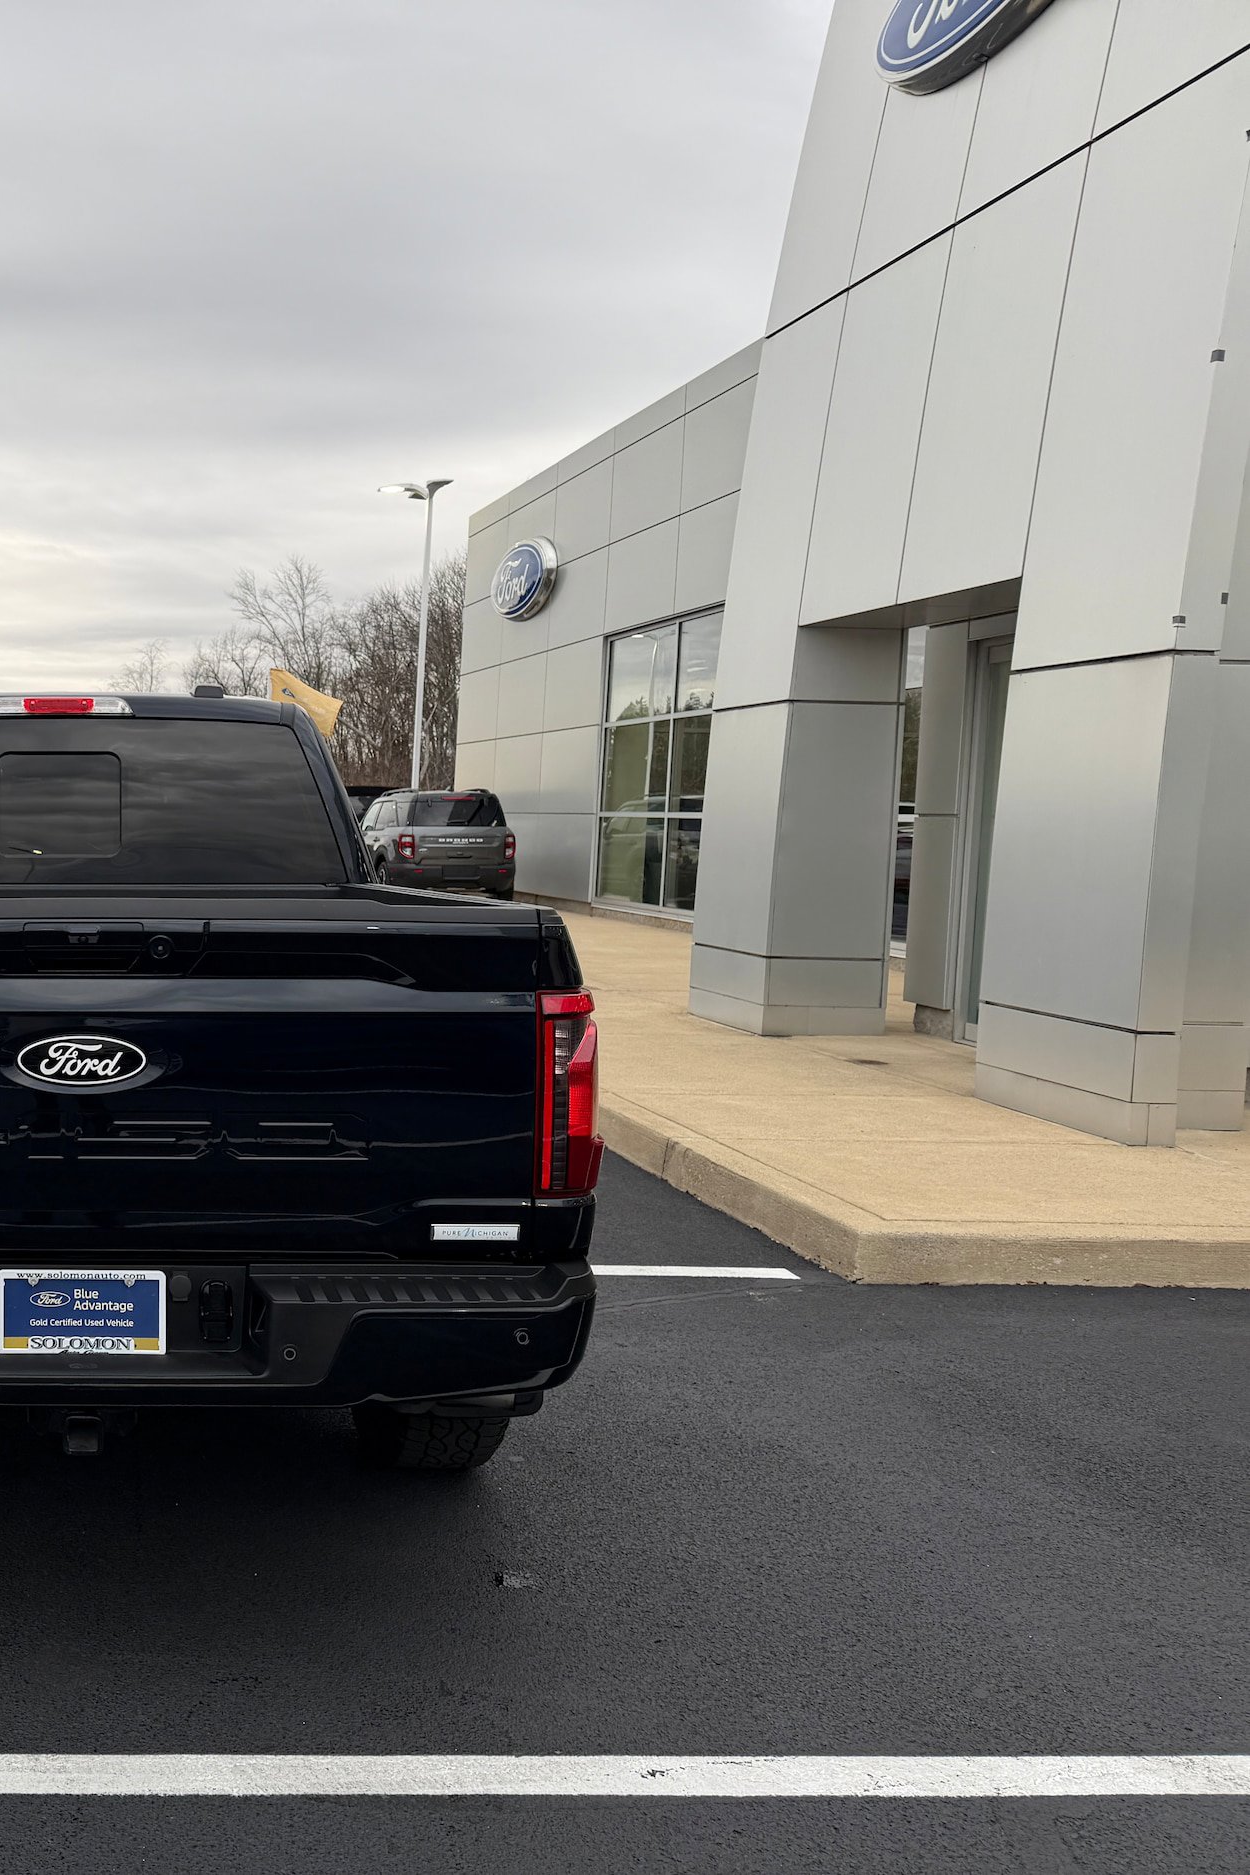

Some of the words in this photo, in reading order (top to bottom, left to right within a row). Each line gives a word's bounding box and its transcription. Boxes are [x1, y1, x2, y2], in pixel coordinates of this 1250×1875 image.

[497, 558, 529, 604] Ford
[40, 1042, 124, 1076] Ford
[463, 1227, 509, 1238] MICHIGAN
[16, 1271, 146, 1280] www.solomonauto.com
[37, 1293, 63, 1305] Ford
[73, 1288, 99, 1299] Blue
[73, 1300, 134, 1313] Advantage
[30, 1318, 48, 1327] Gold
[50, 1318, 83, 1327] Certified
[84, 1318, 104, 1327] Used
[105, 1319, 134, 1327] Vehicle
[30, 1337, 132, 1350] SOLOMON
